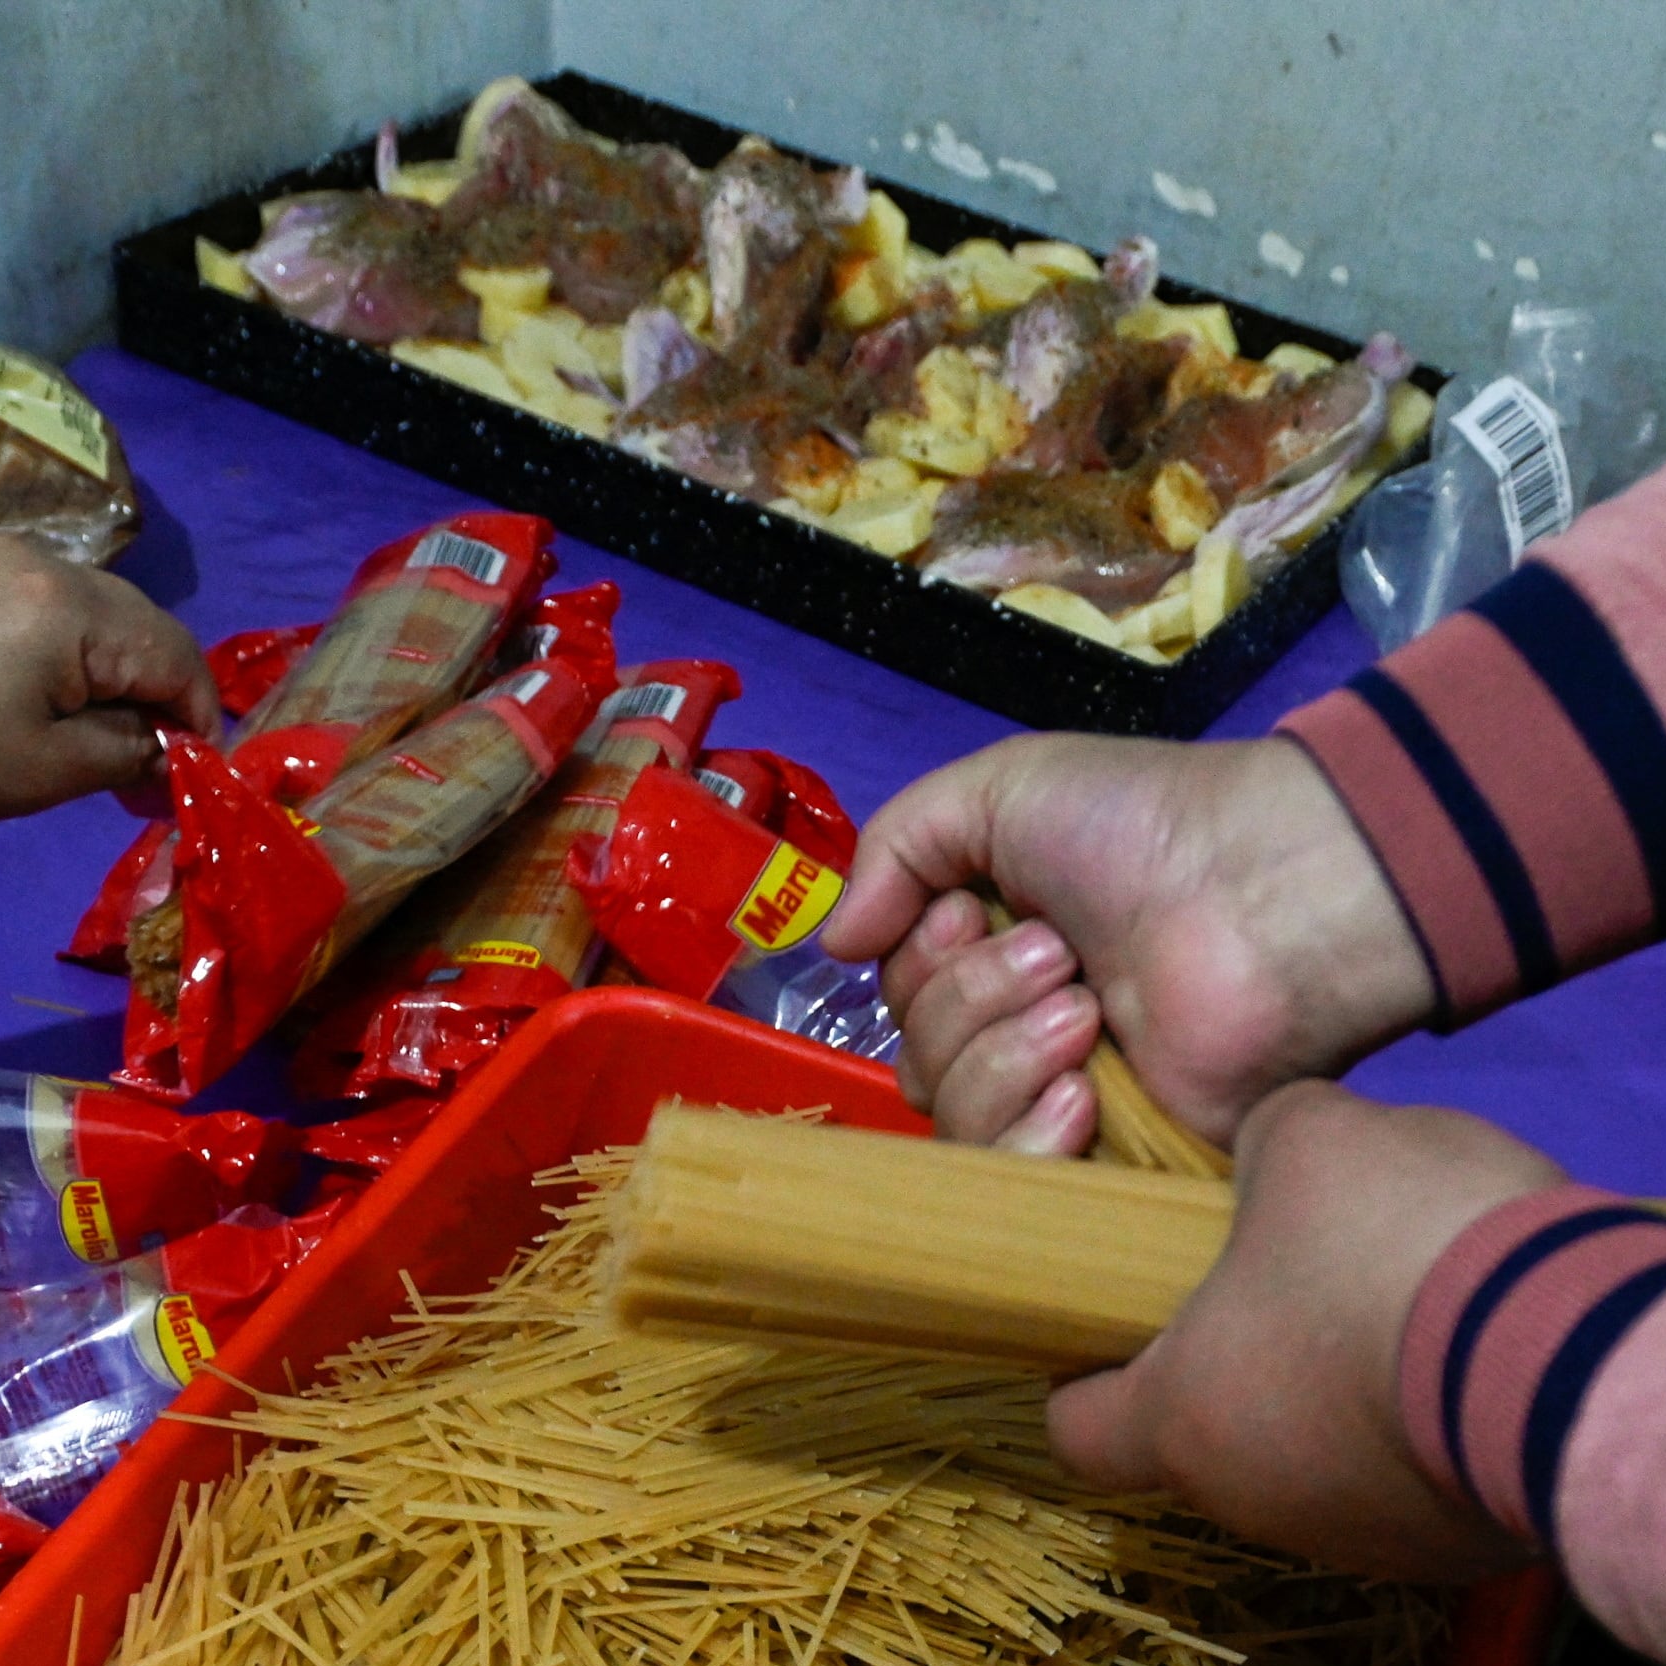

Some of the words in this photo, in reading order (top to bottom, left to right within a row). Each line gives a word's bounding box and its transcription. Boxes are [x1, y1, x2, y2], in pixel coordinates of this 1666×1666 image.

[740, 852, 821, 945] Maro
[72, 1180, 106, 1264] Marolio
[163, 1300, 209, 1376] Maro
